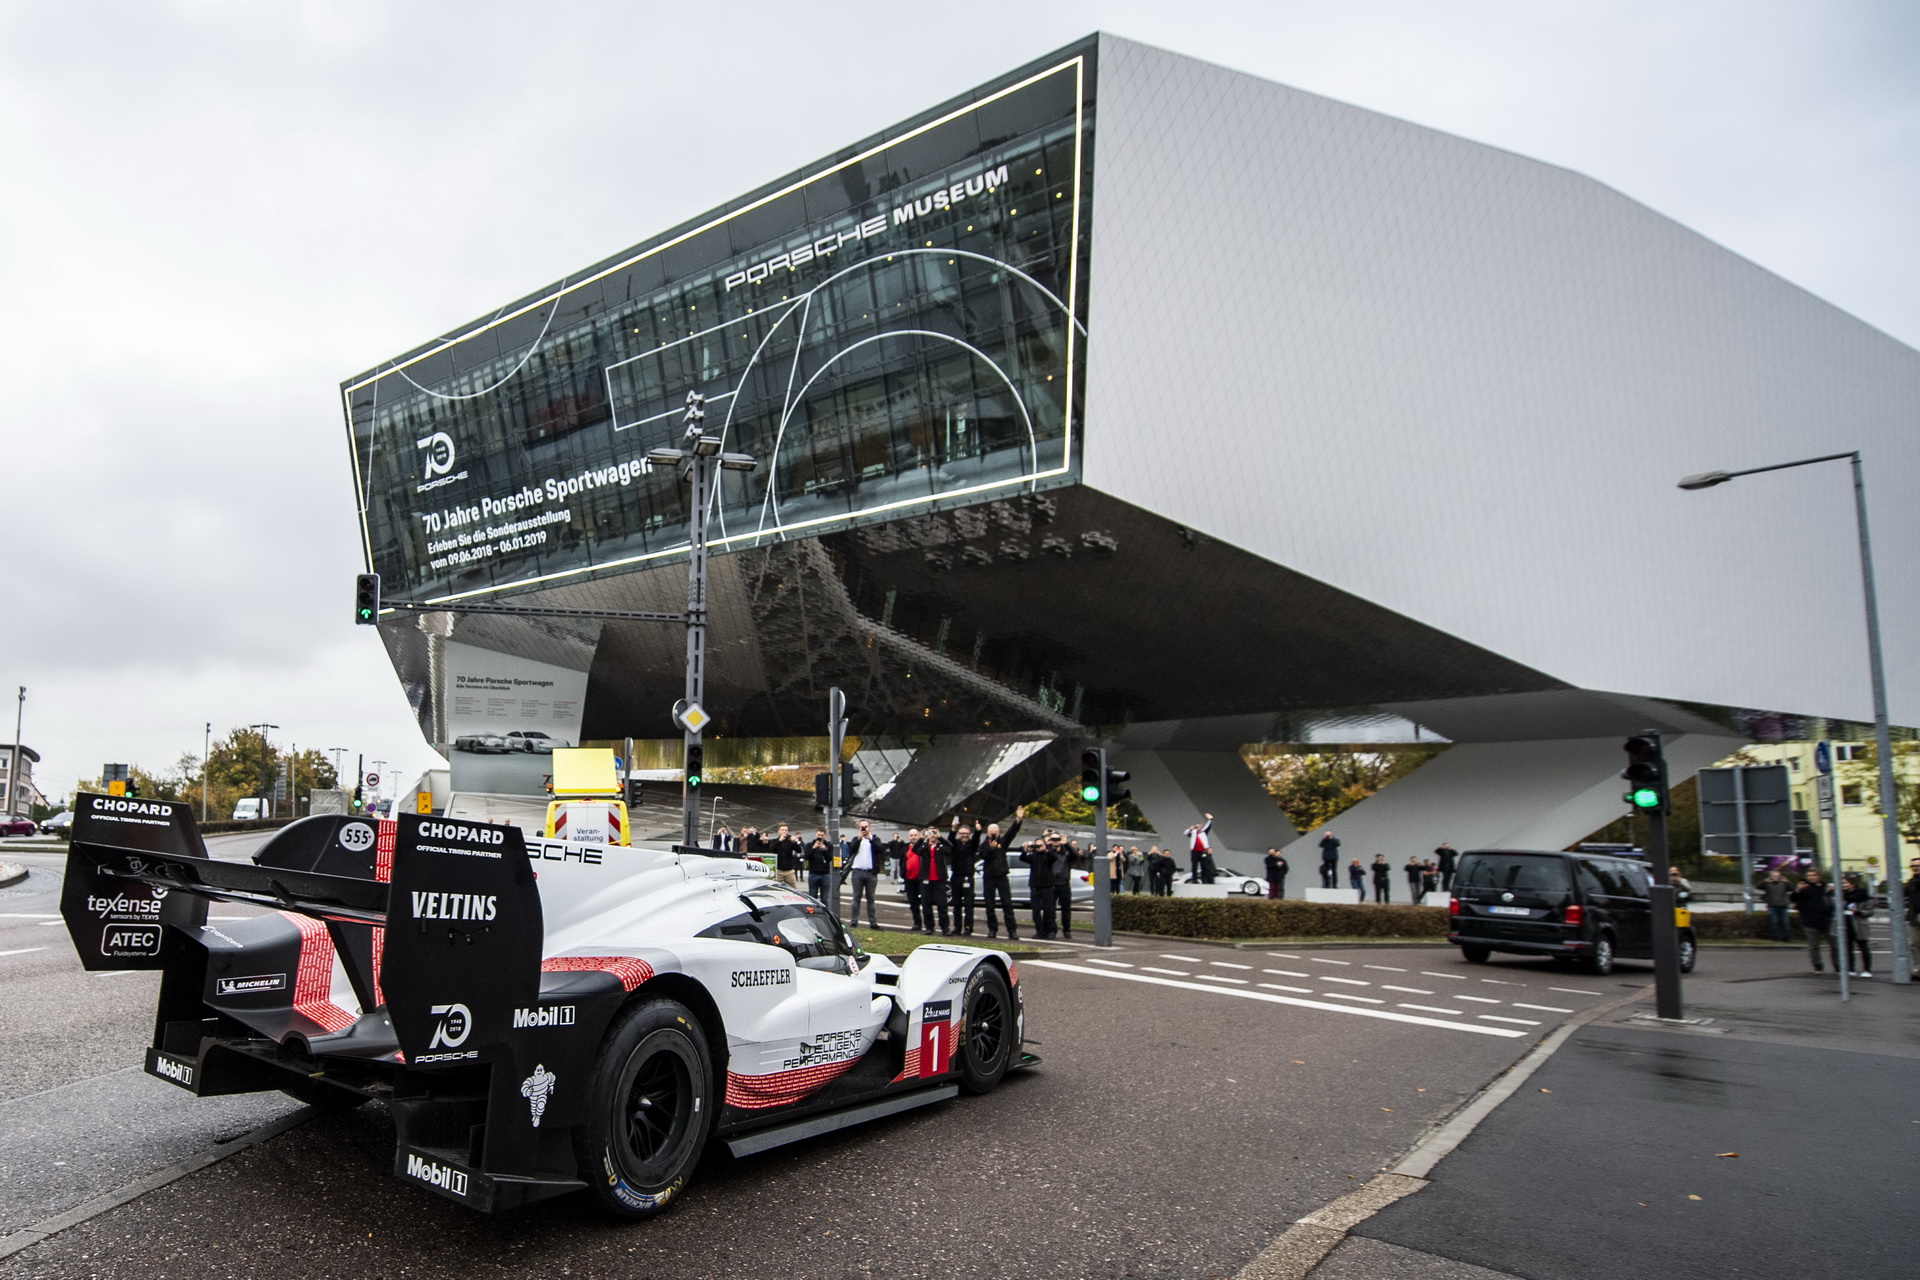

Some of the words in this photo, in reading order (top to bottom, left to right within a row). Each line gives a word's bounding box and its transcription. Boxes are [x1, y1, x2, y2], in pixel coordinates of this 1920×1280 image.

[724, 213, 888, 293] PORSCHE
[892, 164, 1009, 226] MUSEUM
[416, 470, 469, 493] PORSCHE
[422, 512, 441, 535] 70
[443, 505, 480, 530] Jahre
[481, 486, 544, 519] Porsche
[545, 456, 654, 503] Sportwagen
[427, 538, 458, 555] Erleben
[458, 532, 473, 547] Sie
[472, 528, 487, 544] die
[486, 508, 571, 540] Sonderausstellung
[430, 557, 448, 570] vom
[448, 543, 493, 566] 09.06.2018
[500, 530, 547, 554] 06.01.2019
[467, 676, 485, 684] Jahre
[485, 677, 513, 686] Porsche
[513, 678, 554, 687] Sportwagen
[92, 798, 172, 816] CHOPARD
[91, 814, 120, 822] OFFICIAL
[120, 816, 142, 824] TIMING
[142, 819, 171, 827] PARTNER
[344, 828, 370, 845] 555
[418, 821, 504, 844] CHOPARD
[573, 833, 604, 843] staltung
[416, 844, 449, 854] OFFICIAL
[449, 847, 472, 857] TIMING
[471, 850, 502, 859] PARTNER
[87, 892, 162, 919] texense
[412, 891, 497, 920] VELTINS
[109, 932, 155, 947] ATEC
[113, 950, 147, 958] Fluidsysteme
[236, 978, 280, 989] MICHELIN
[731, 968, 791, 988] SCHAEFFLER
[513, 1006, 558, 1028] Mobil
[815, 1028, 862, 1044] PORSCHE
[415, 1050, 478, 1064] PORSCHE
[783, 1047, 860, 1070] PERFORMANCE
[929, 1025, 939, 1073] 1
[156, 1056, 183, 1081] Mobil
[407, 1153, 452, 1190] Mobil
